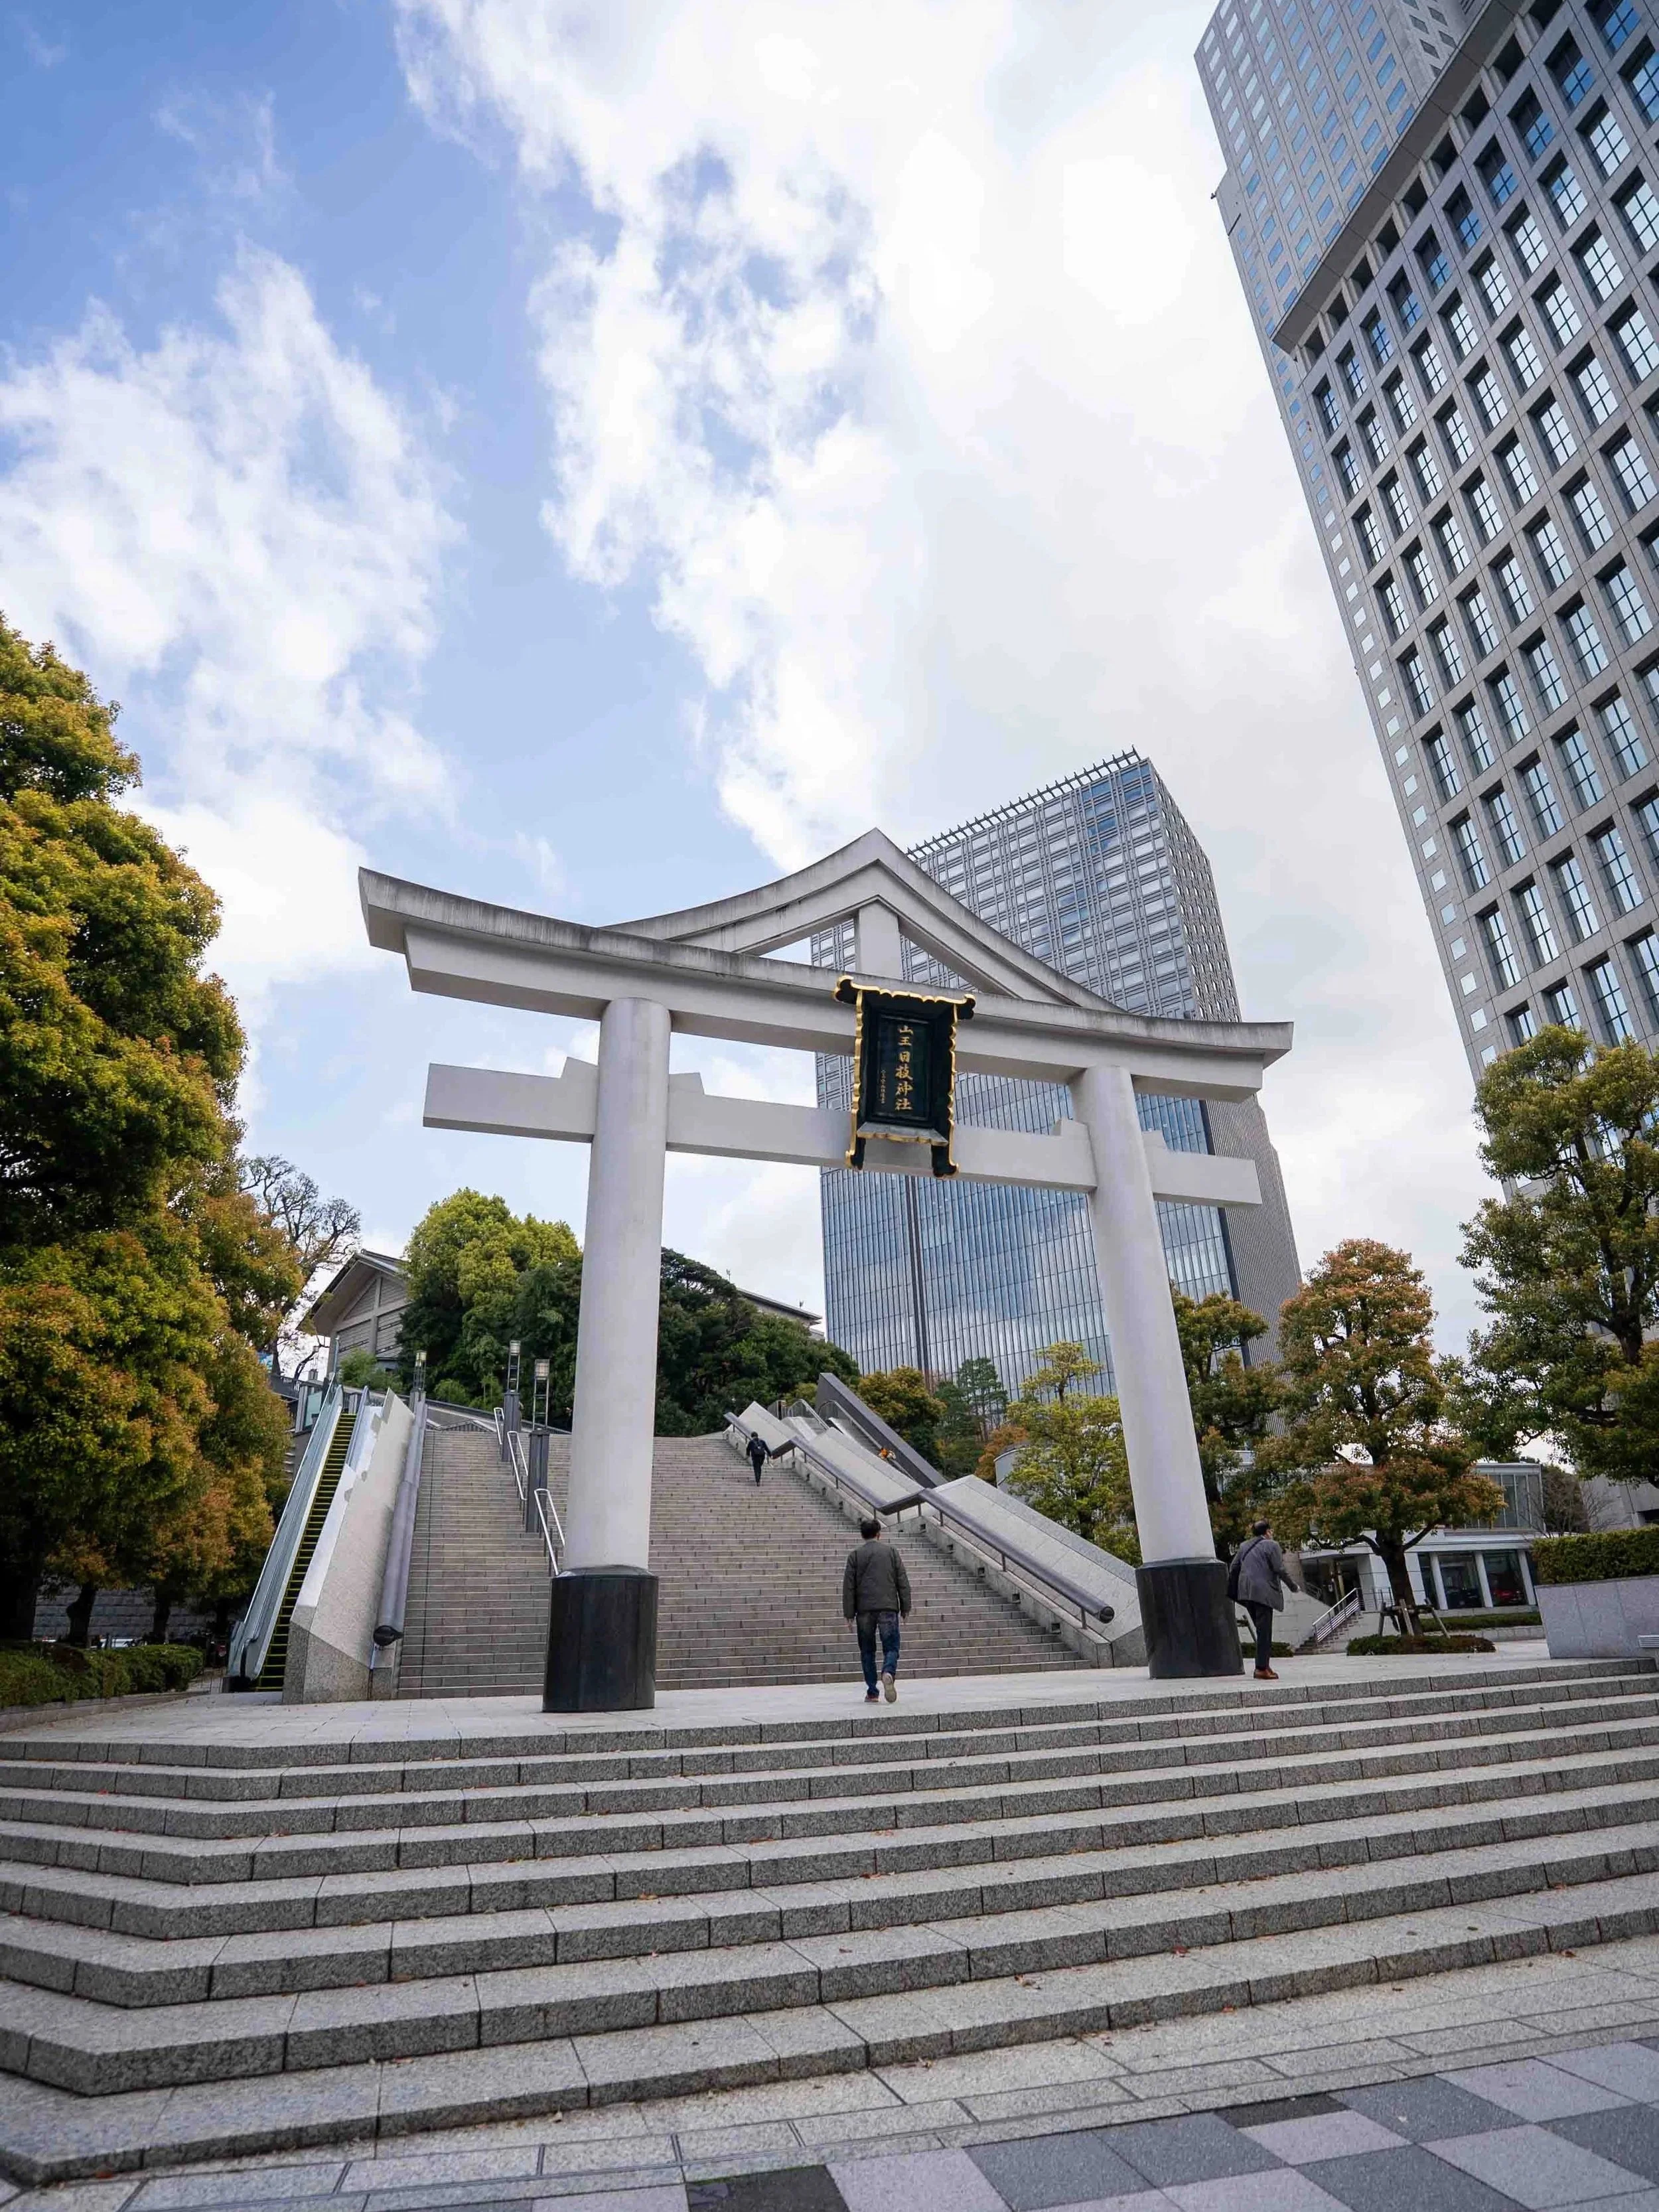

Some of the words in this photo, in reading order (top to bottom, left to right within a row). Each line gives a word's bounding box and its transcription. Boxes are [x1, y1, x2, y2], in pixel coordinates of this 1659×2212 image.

[895, 1025, 914, 1111] 山王日枝神社
